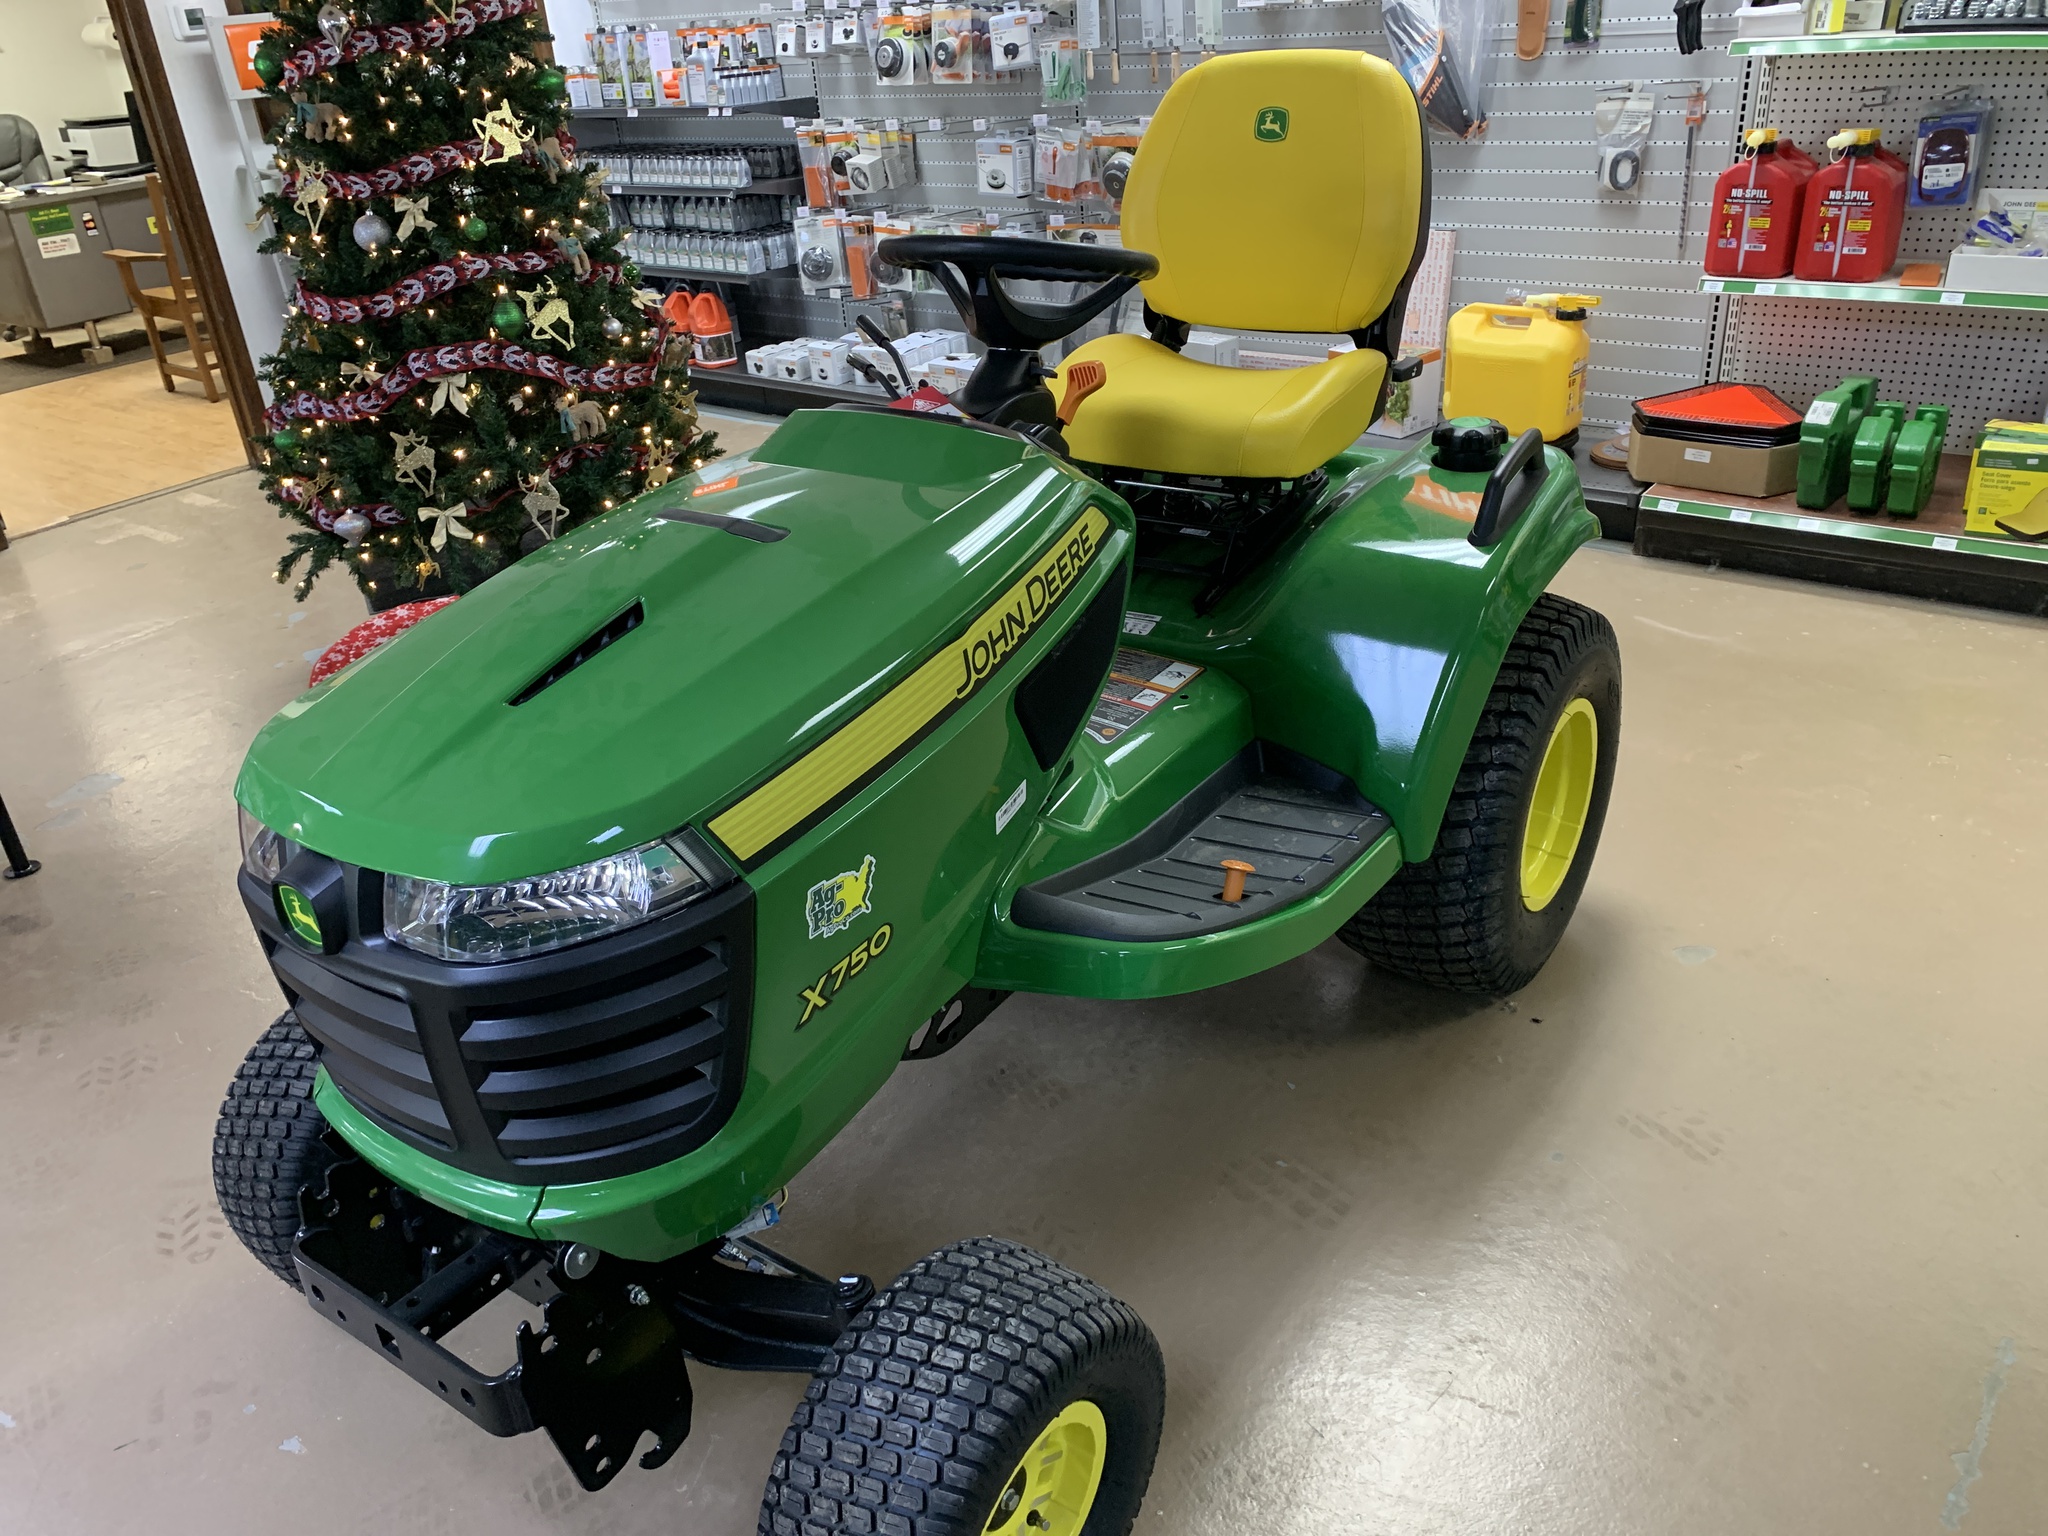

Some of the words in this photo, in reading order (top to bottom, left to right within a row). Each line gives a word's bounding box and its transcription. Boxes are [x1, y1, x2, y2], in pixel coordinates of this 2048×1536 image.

[1422, 76, 1443, 108] STIHL
[1730, 188, 1768, 199] NO-SPILL
[1828, 190, 1869, 201] NO-SPILL
[956, 600, 1026, 696] JOHN
[1025, 522, 1094, 618] DEERE
[811, 882, 844, 914] Ag-
[811, 900, 845, 935] Pro
[799, 924, 892, 1026] X750
